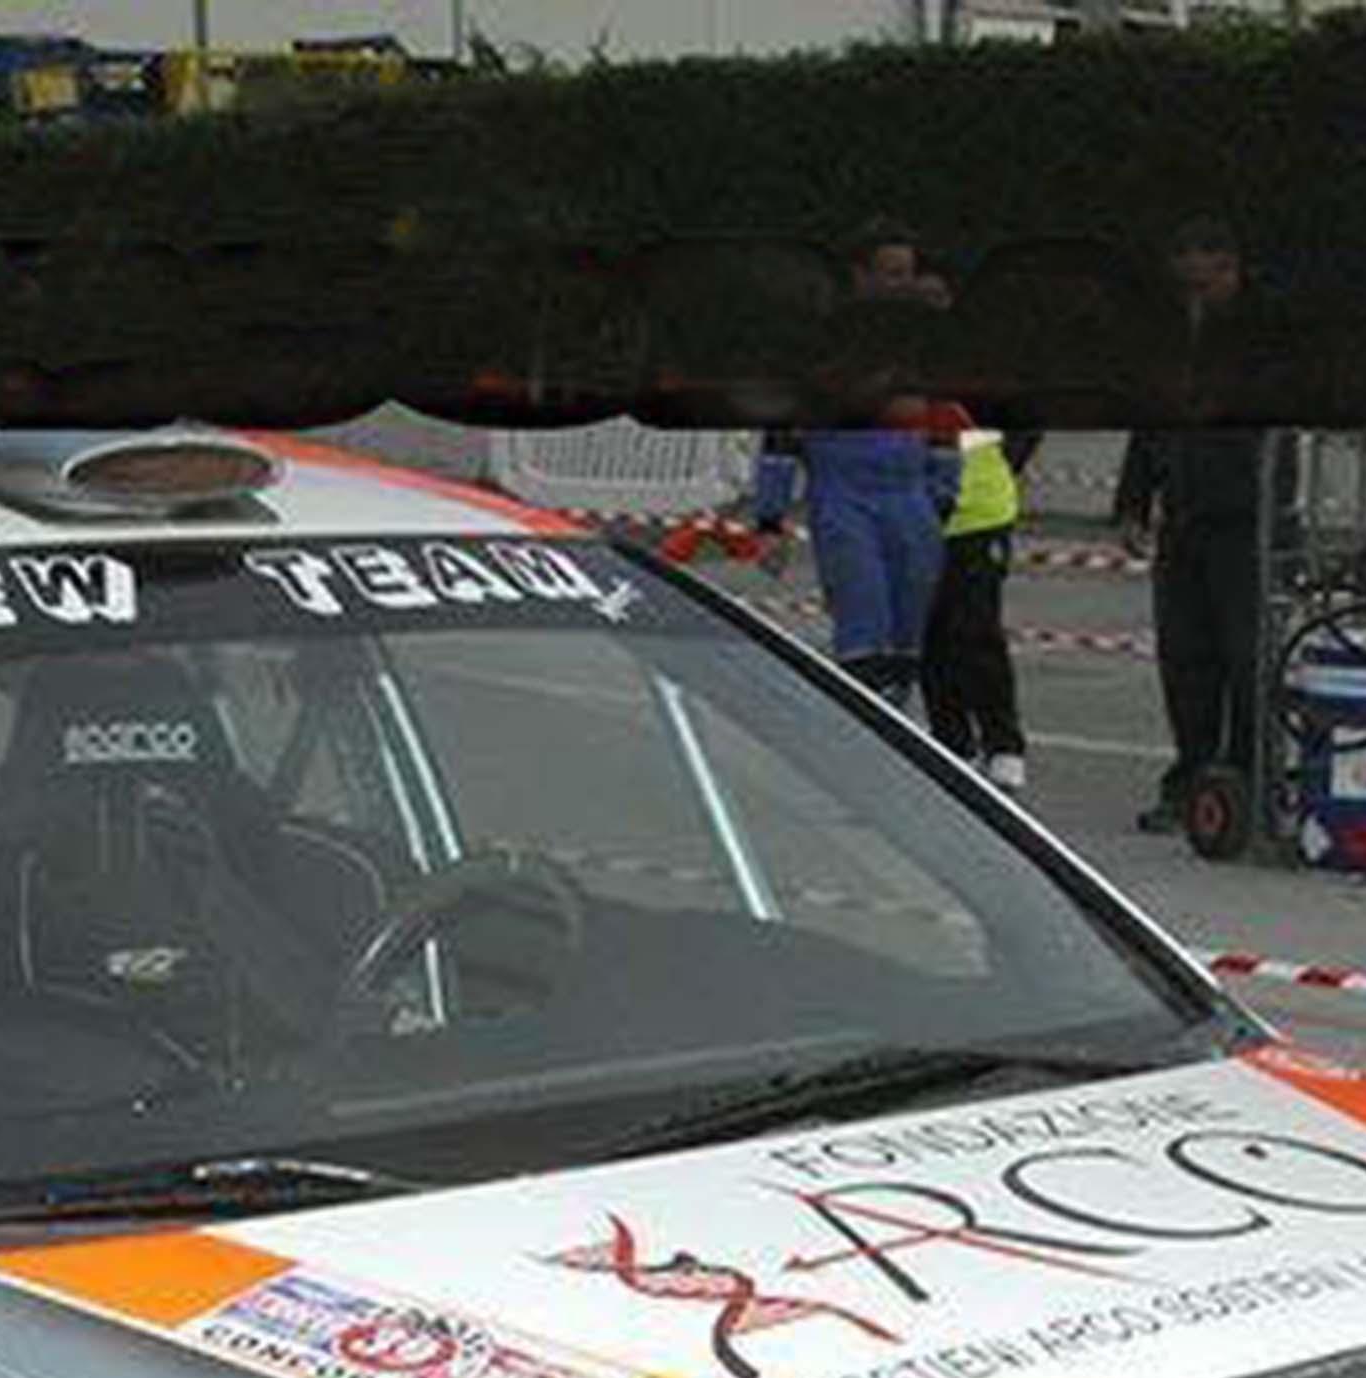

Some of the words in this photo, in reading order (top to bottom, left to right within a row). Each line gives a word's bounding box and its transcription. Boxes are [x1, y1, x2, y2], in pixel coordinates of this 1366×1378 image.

[244, 543, 602, 615] TEAM
[769, 1091, 1239, 1182] FONDAZIONE
[1028, 1308, 1164, 1358] ARCO
